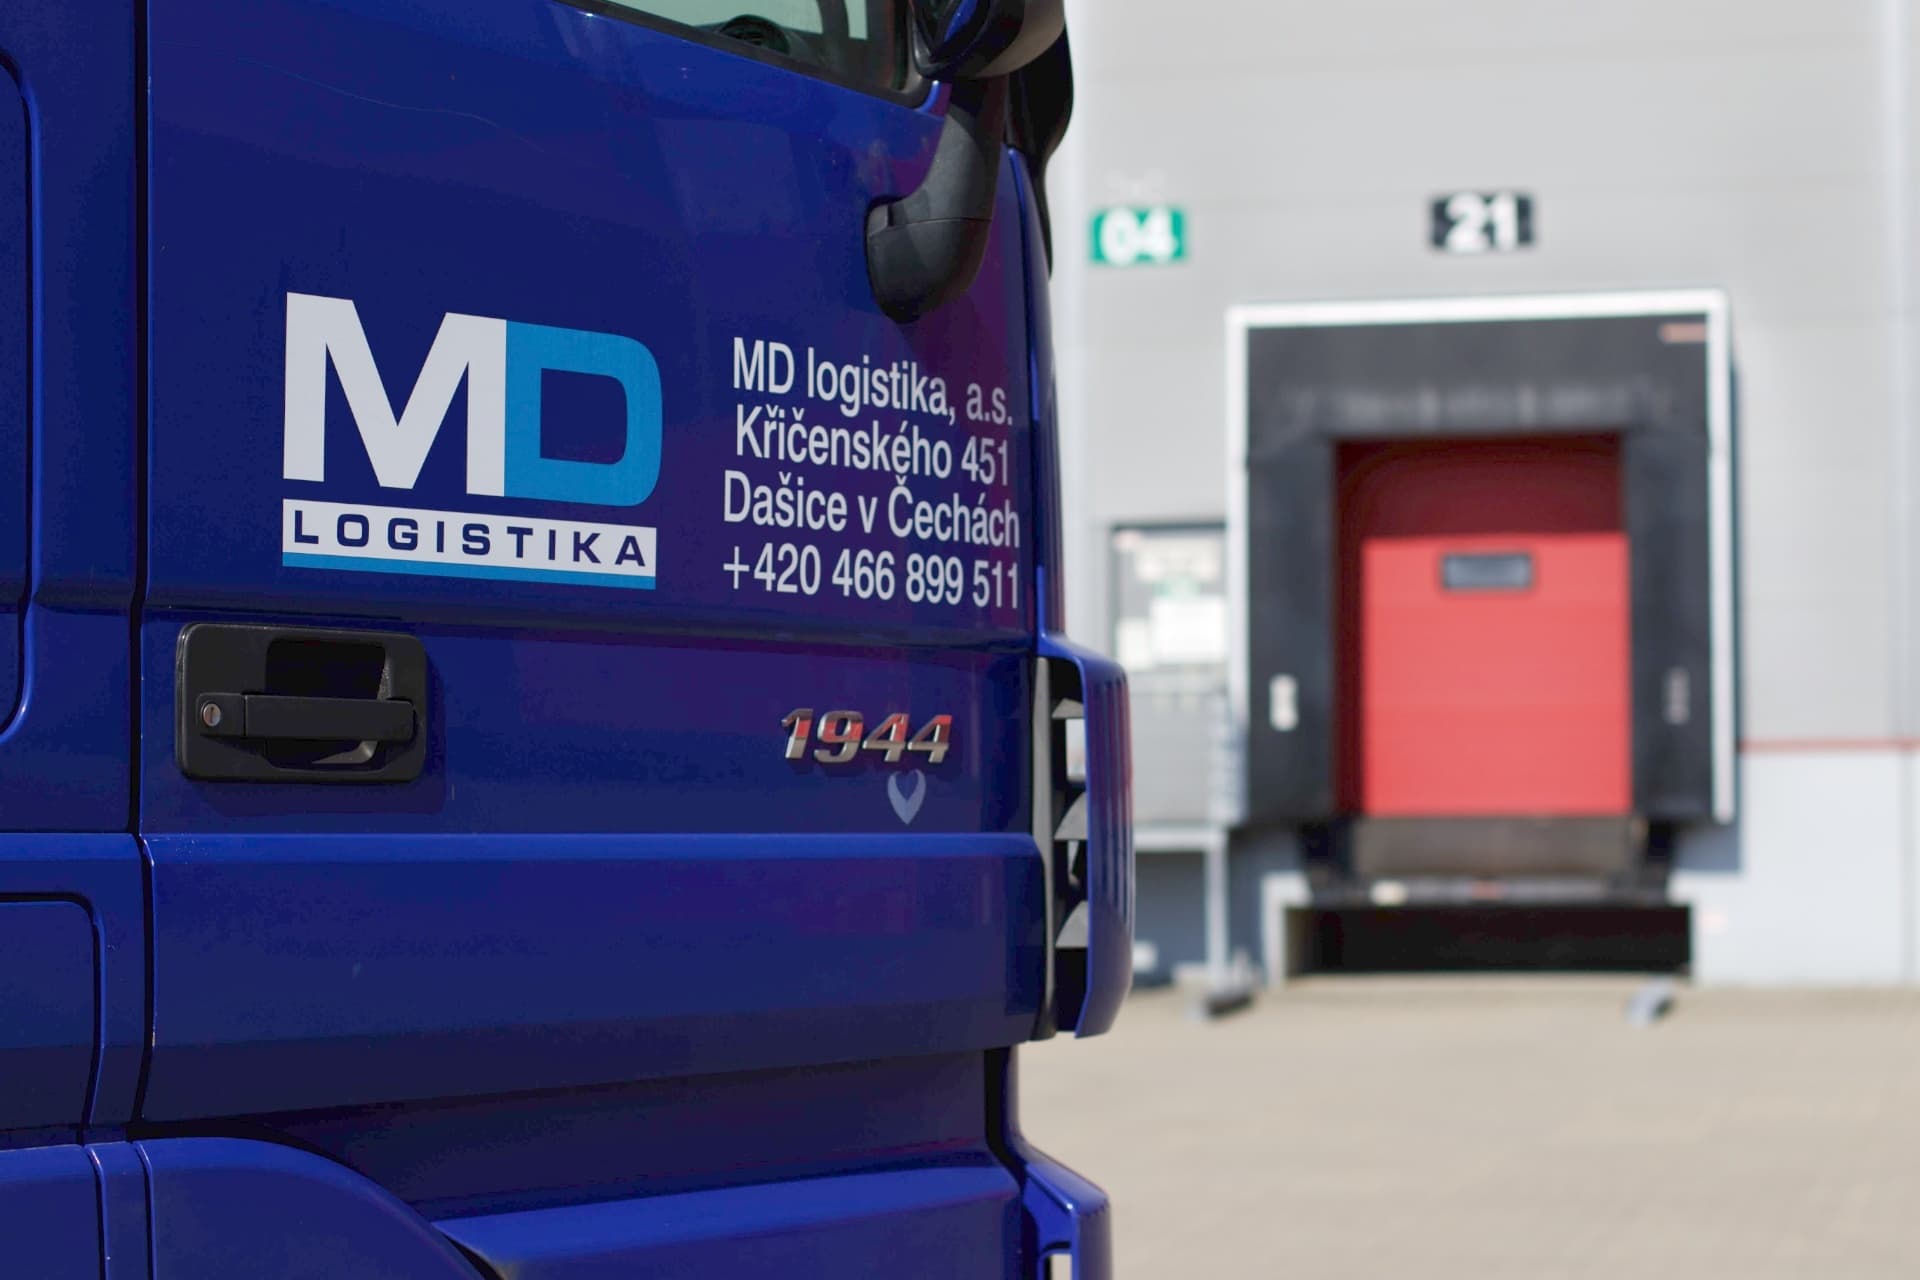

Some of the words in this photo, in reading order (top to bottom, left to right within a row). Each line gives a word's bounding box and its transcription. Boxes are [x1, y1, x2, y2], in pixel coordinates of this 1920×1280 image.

[1101, 207, 1178, 265] 04
[1445, 193, 1518, 253] 21
[283, 292, 663, 507] MD
[733, 337, 795, 394] MD
[807, 347, 956, 425] logistika,
[966, 382, 1013, 426] a.s.
[736, 403, 952, 479] Křičenského
[961, 436, 1008, 486] 451
[294, 510, 646, 567] LOGISTIKA
[724, 469, 848, 532] Dašice
[857, 495, 878, 534] v
[888, 474, 1020, 548] Čechách
[723, 542, 821, 595] +420
[832, 548, 895, 600] 466
[906, 553, 964, 605] 899
[973, 560, 1018, 609] 511
[781, 708, 952, 763] 1944
